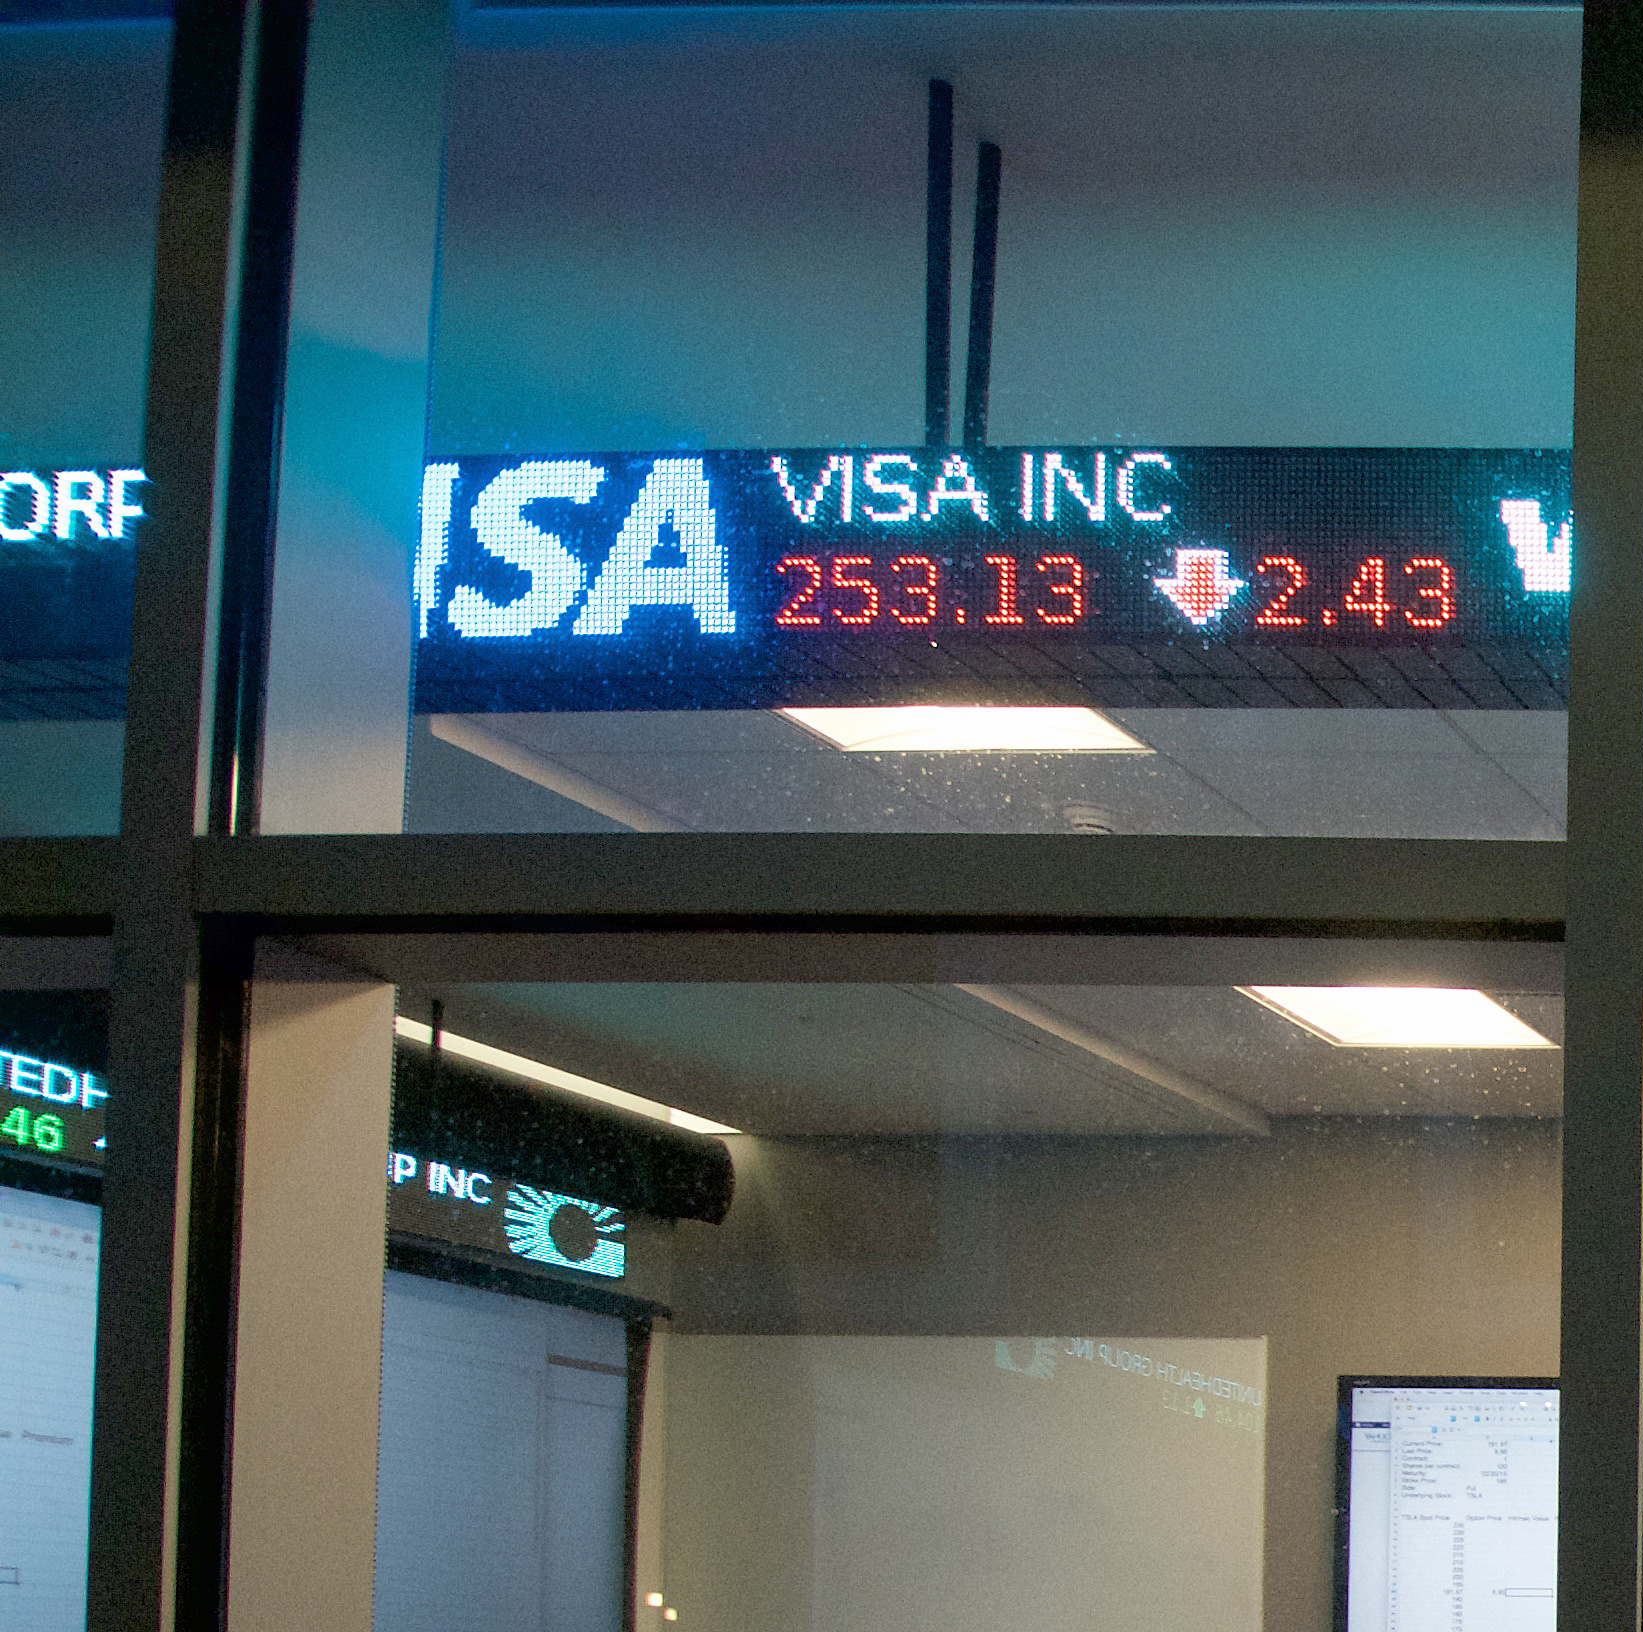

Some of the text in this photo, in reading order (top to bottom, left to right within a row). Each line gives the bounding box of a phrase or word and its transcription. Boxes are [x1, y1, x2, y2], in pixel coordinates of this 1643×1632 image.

[0, 470, 147, 541] ORP
[770, 453, 1172, 522] VISA INC
[414, 458, 736, 638] ISA
[775, 556, 1085, 625] 253.13
[1256, 556, 1455, 627] 2.43
[427, 1161, 492, 1204] INC
